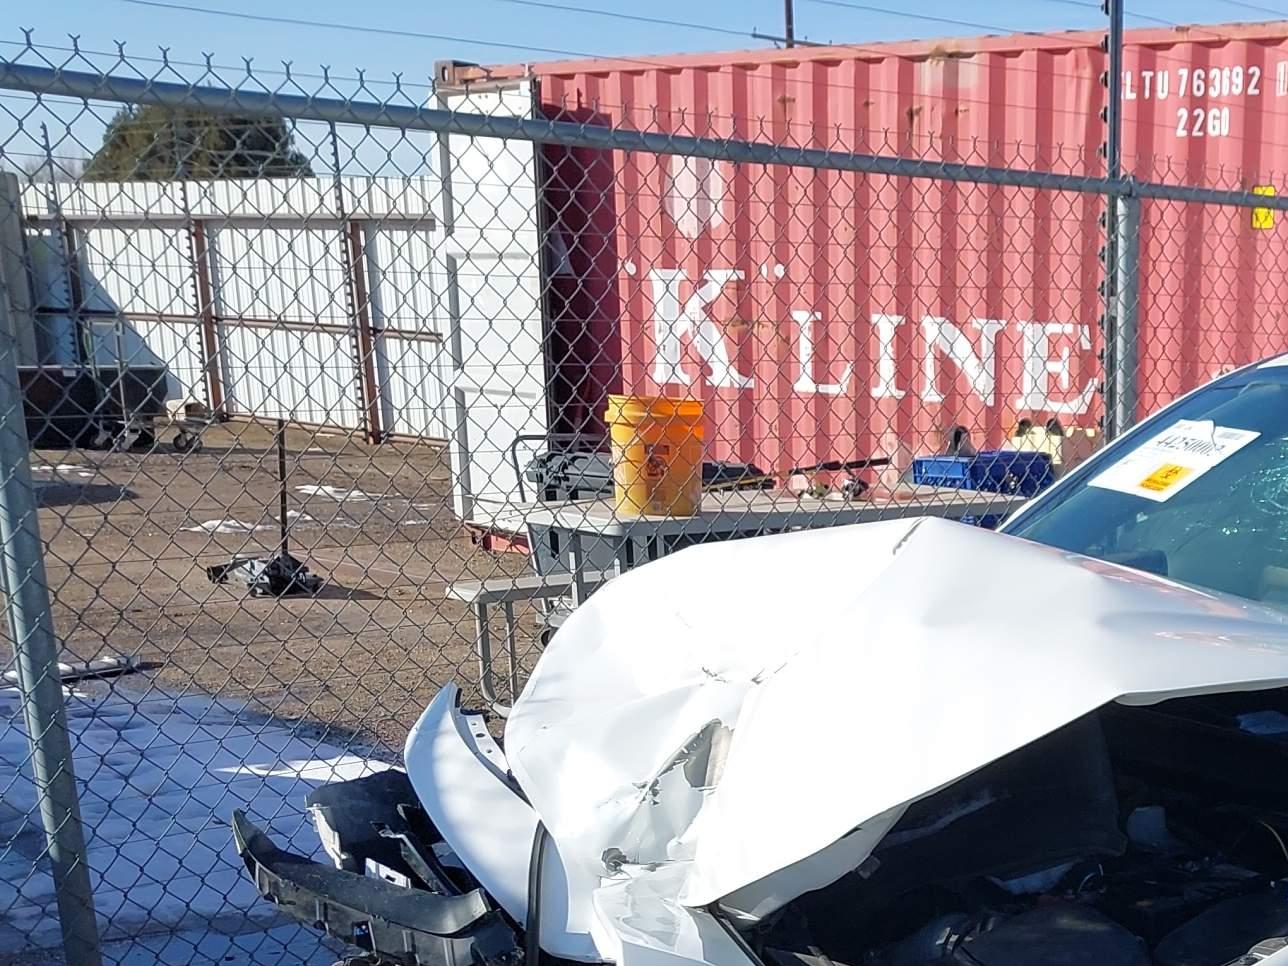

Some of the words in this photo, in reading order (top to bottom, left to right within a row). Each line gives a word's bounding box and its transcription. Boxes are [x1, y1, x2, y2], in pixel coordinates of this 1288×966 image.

[1121, 70, 1169, 99] LTU
[1177, 65, 1261, 97] 763692
[792, 310, 1099, 415] LINE
